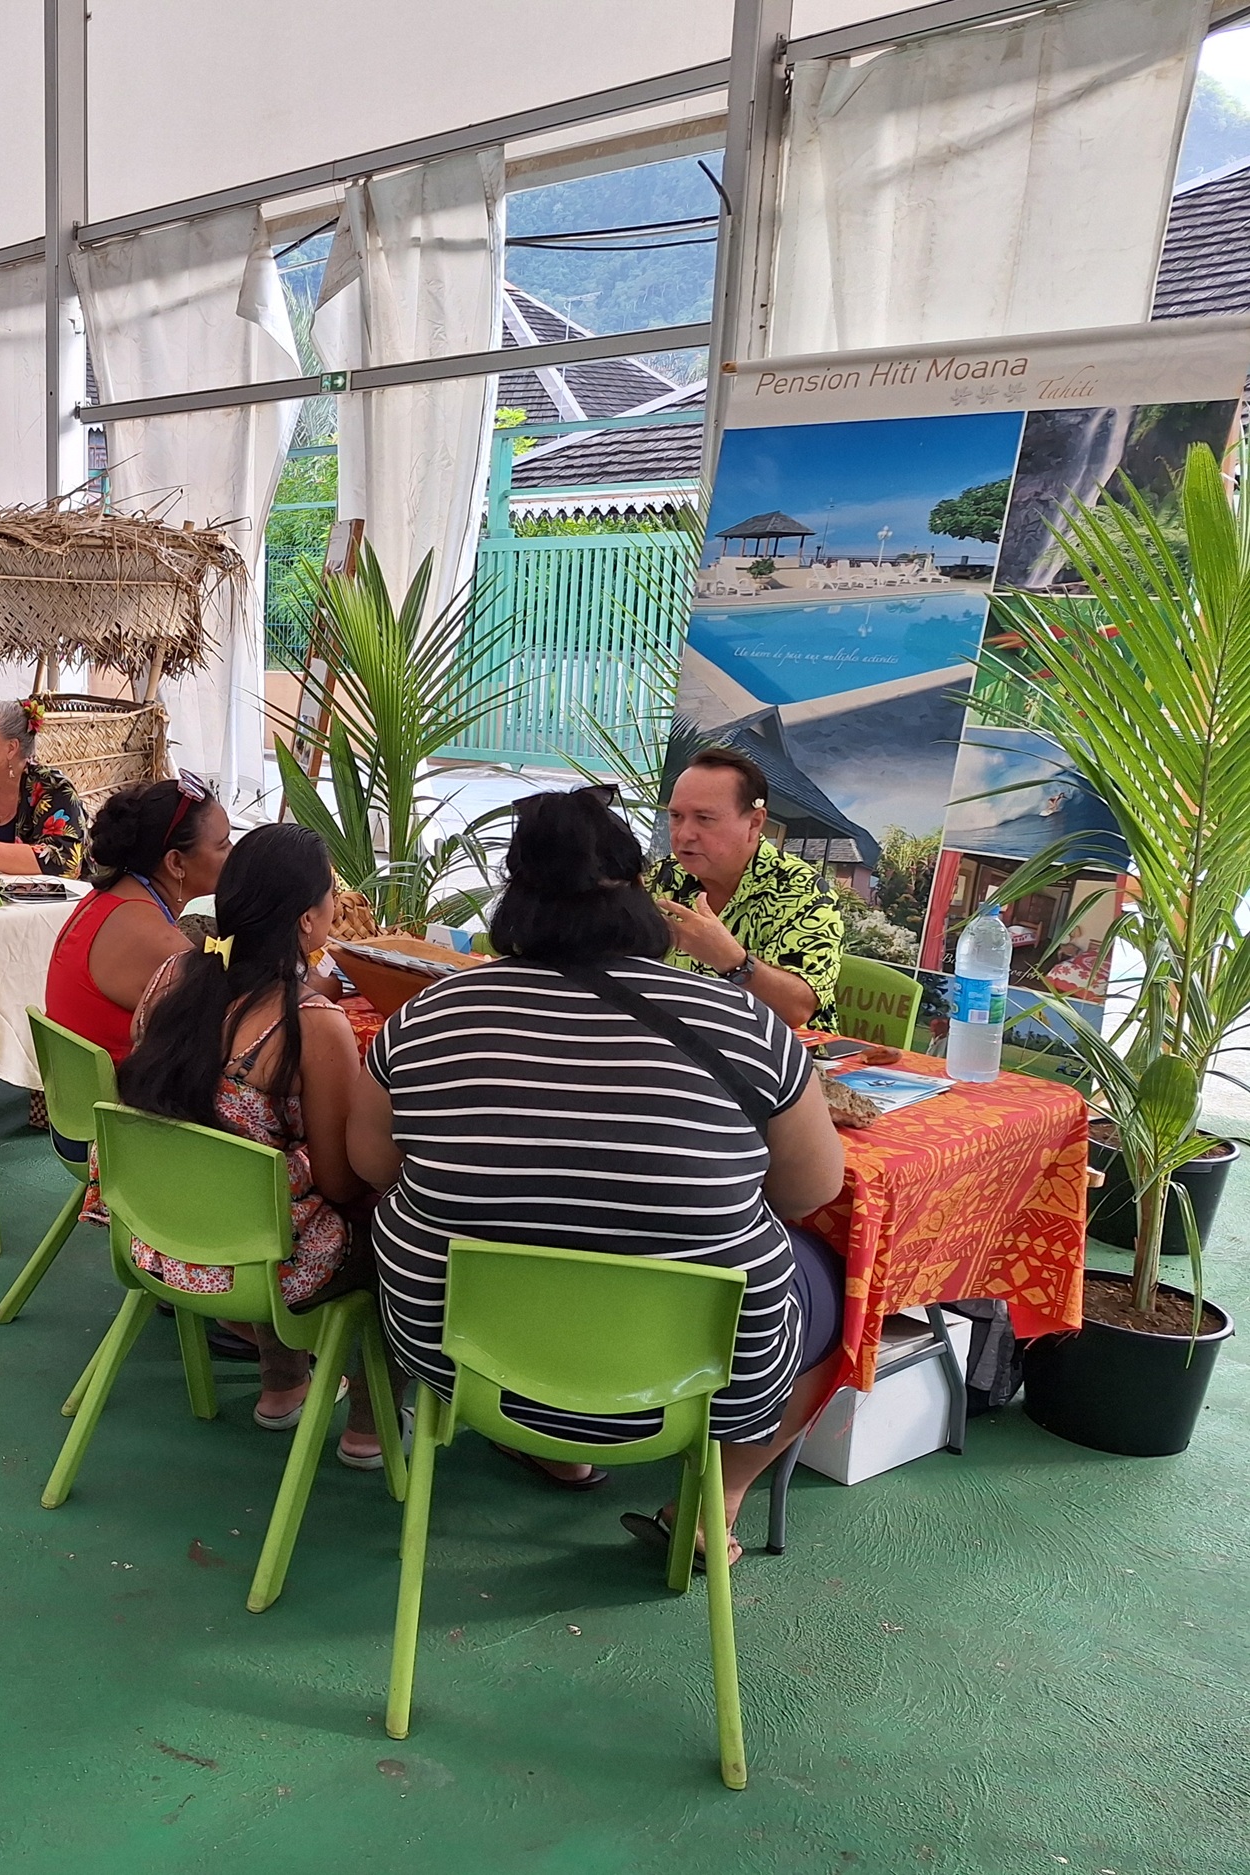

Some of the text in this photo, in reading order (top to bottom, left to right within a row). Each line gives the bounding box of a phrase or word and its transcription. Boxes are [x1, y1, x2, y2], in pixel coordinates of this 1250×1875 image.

[754, 356, 1029, 397] Pension Hiti Moana
[1035, 365, 1099, 400] Tahiti
[777, 651, 802, 667] paix
[804, 653, 820, 665] aux
[822, 647, 860, 670] multiples
[862, 653, 899, 664] activités
[834, 984, 912, 1021] MUNE
